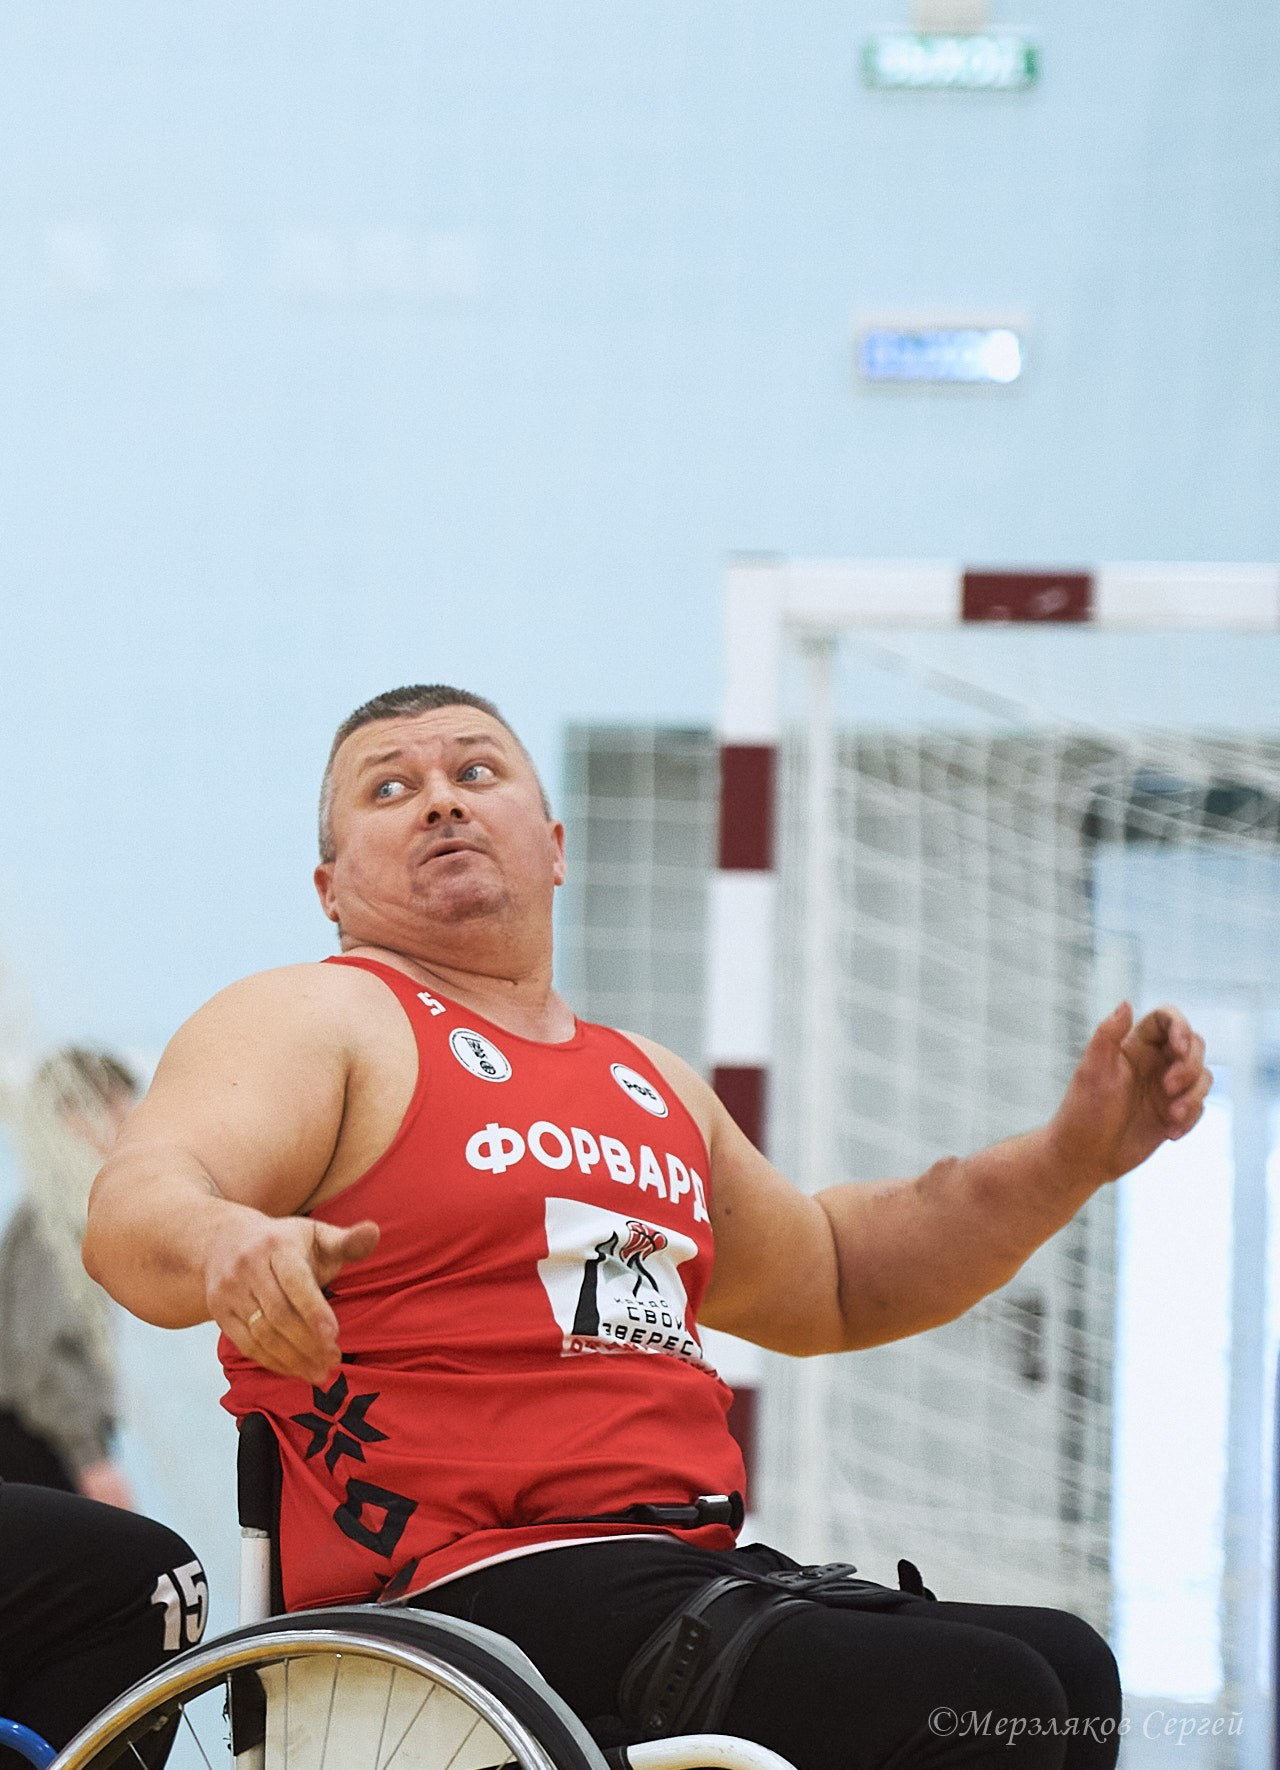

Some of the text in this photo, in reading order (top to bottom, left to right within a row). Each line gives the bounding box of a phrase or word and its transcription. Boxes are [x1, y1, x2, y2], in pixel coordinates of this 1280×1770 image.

[465, 1120, 710, 1224] ФОРВАРД
[602, 1322, 703, 1359] ЭВЕРЕС
[151, 1560, 208, 1650] 15
